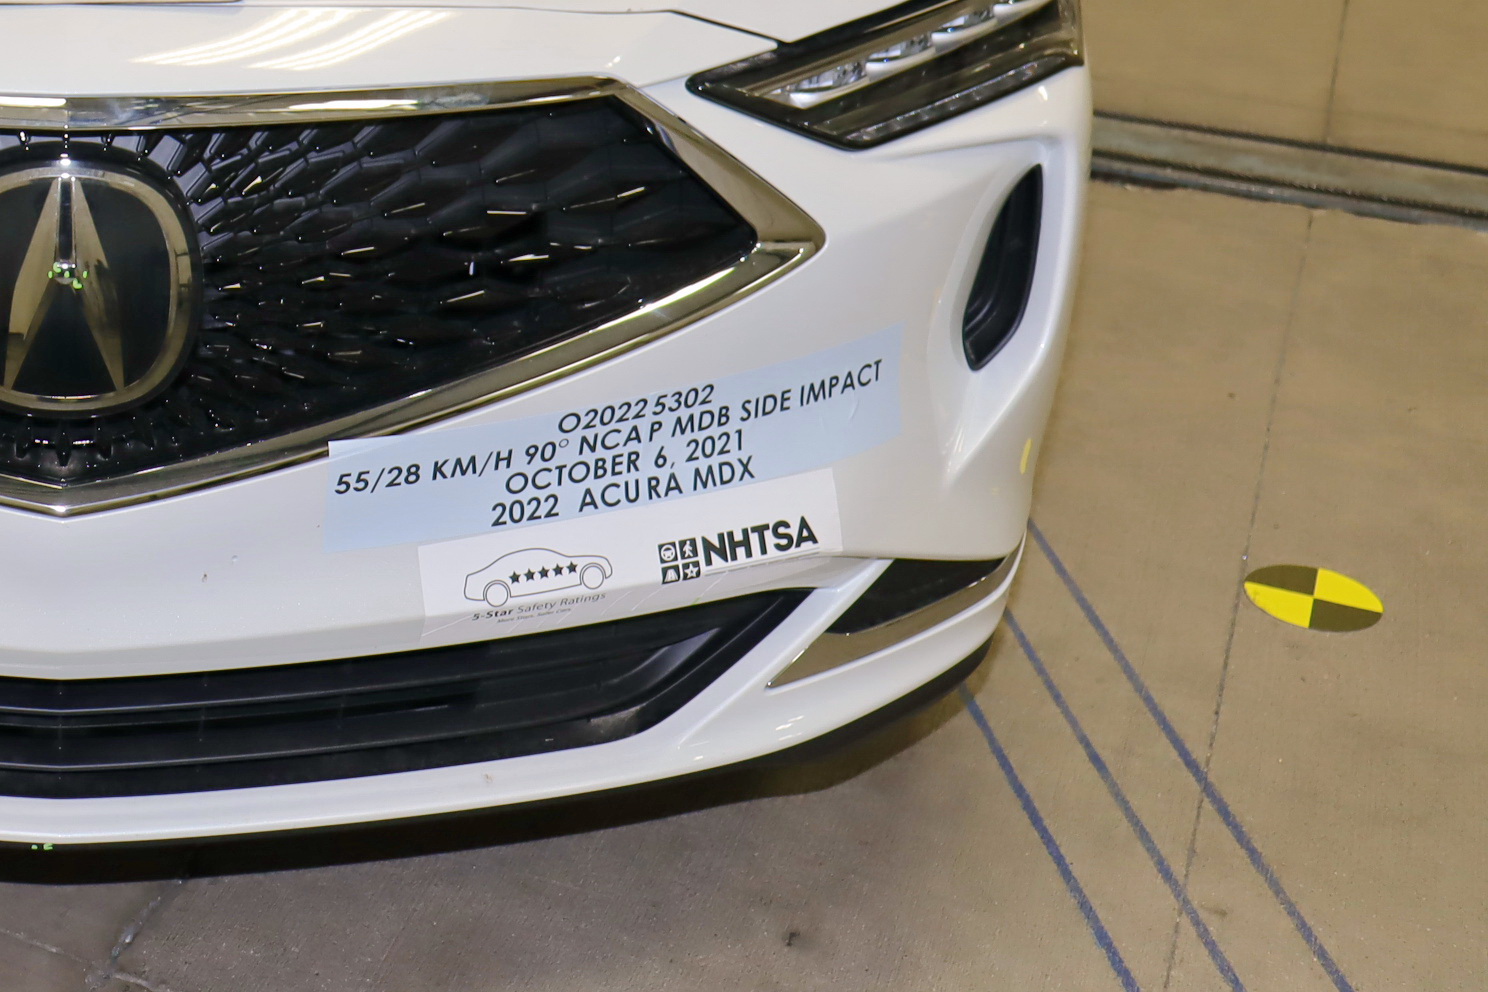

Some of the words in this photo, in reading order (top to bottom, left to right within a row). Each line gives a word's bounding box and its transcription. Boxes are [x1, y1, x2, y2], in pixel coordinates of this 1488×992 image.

[333, 462, 422, 496] 55/28
[431, 448, 514, 482] KM/H
[524, 437, 570, 466] 90°
[577, 420, 663, 456] NCAP
[670, 405, 731, 438] MDB
[739, 388, 793, 423] SIDE
[799, 358, 883, 407] IMPACT
[490, 493, 560, 528] 2022
[577, 471, 684, 513] ACURA
[691, 454, 756, 492] MDX
[504, 450, 641, 495] OCTOBER
[653, 445, 675, 471] 6,
[684, 428, 744, 464] 2021
[700, 514, 820, 568] NHTSA
[471, 608, 514, 622] 5-Star
[516, 601, 558, 615] Safety
[559, 592, 607, 608] Ratings
